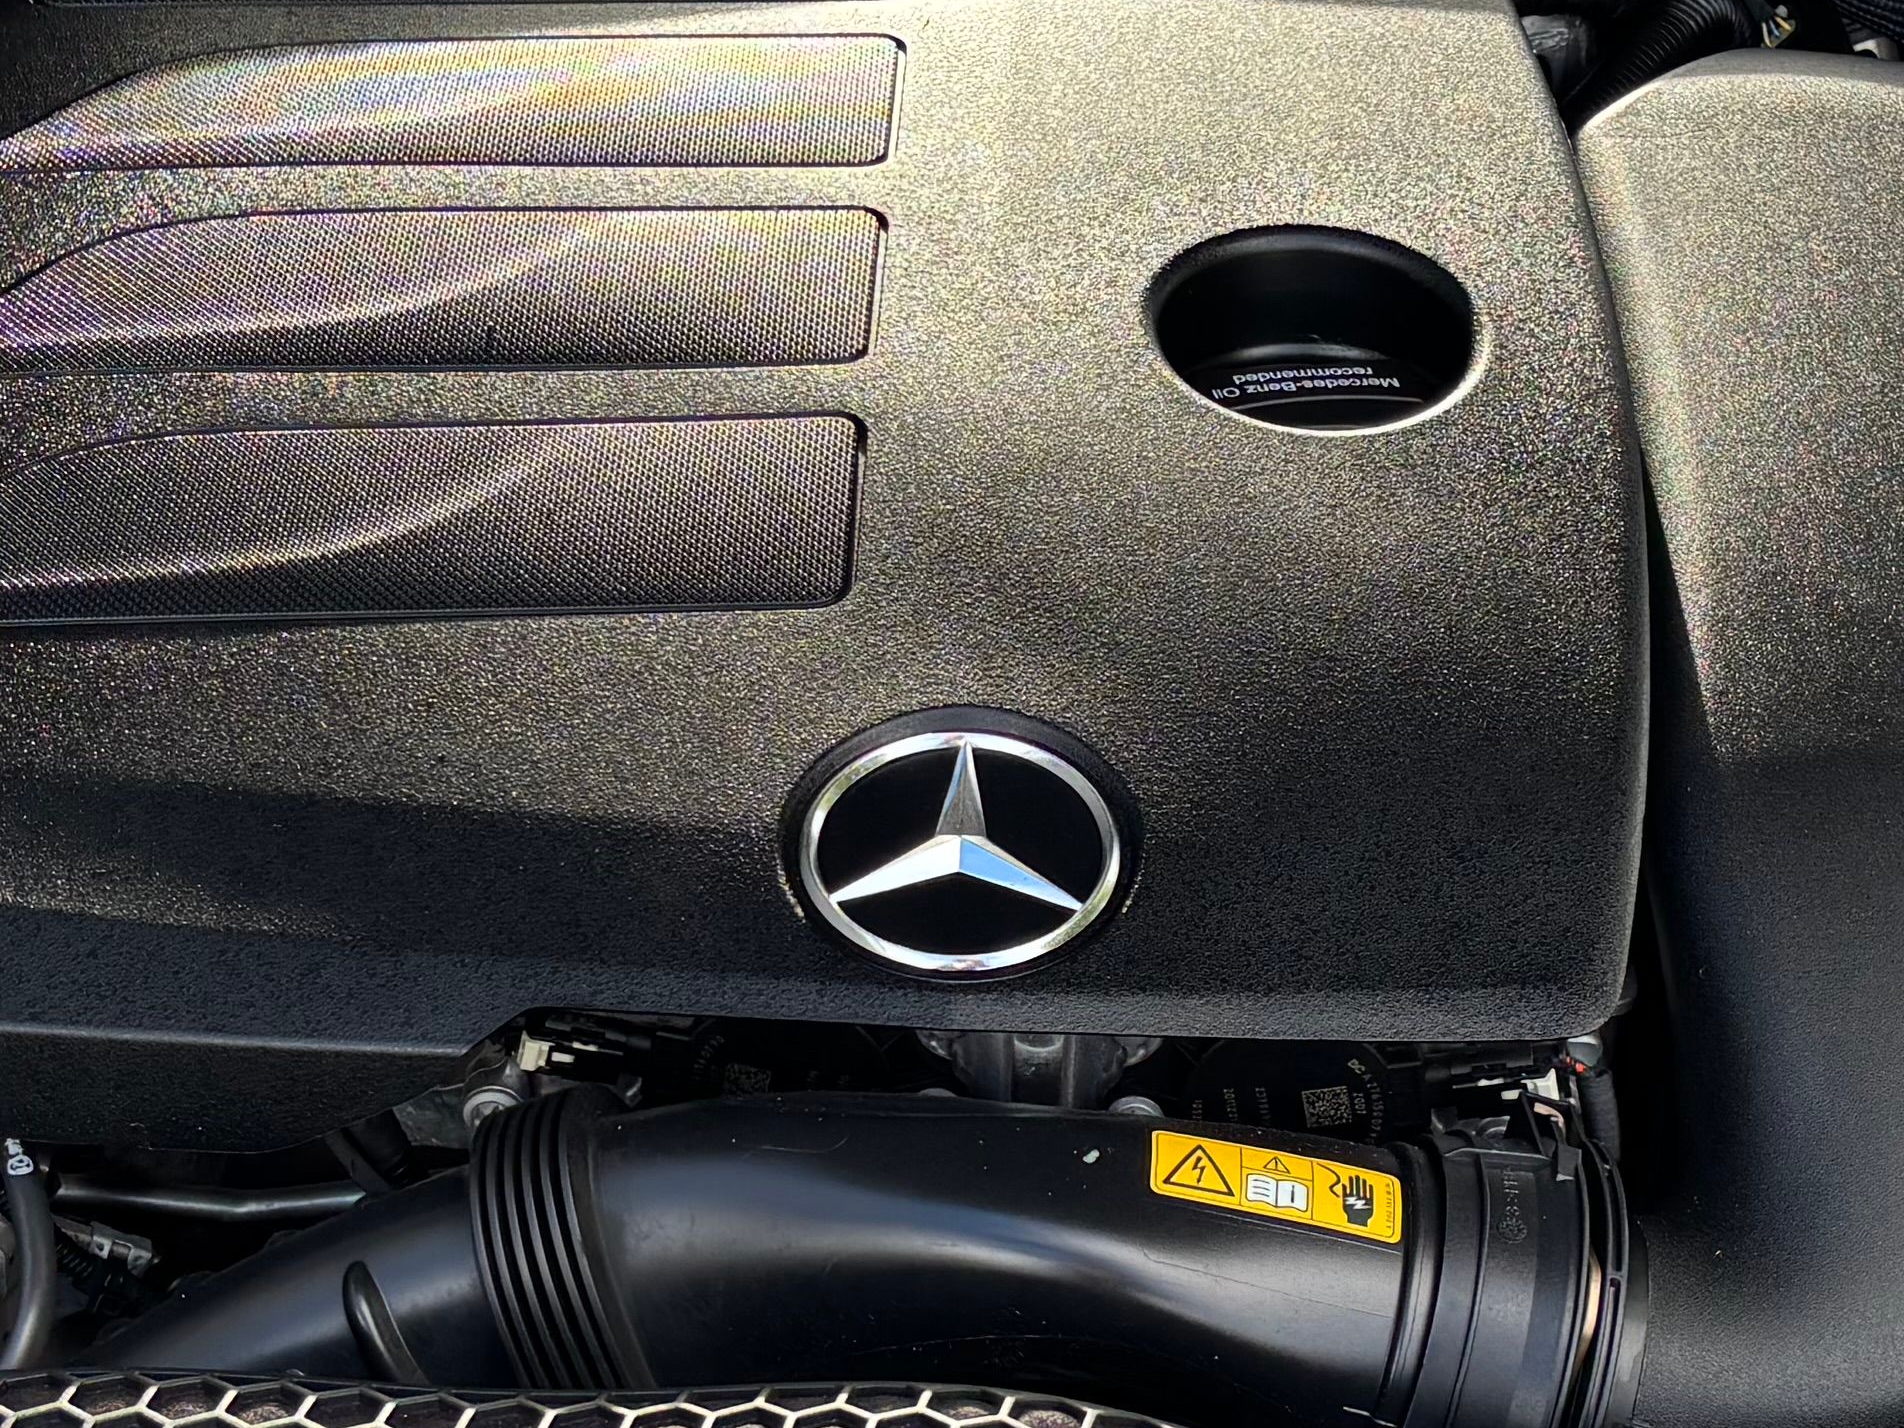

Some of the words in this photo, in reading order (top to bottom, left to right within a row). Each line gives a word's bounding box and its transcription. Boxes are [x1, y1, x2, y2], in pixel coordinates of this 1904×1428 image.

[1232, 365, 1373, 385] recommended
[1211, 386, 1240, 399] Oil
[1244, 376, 1400, 393] Mercedes-Benz
